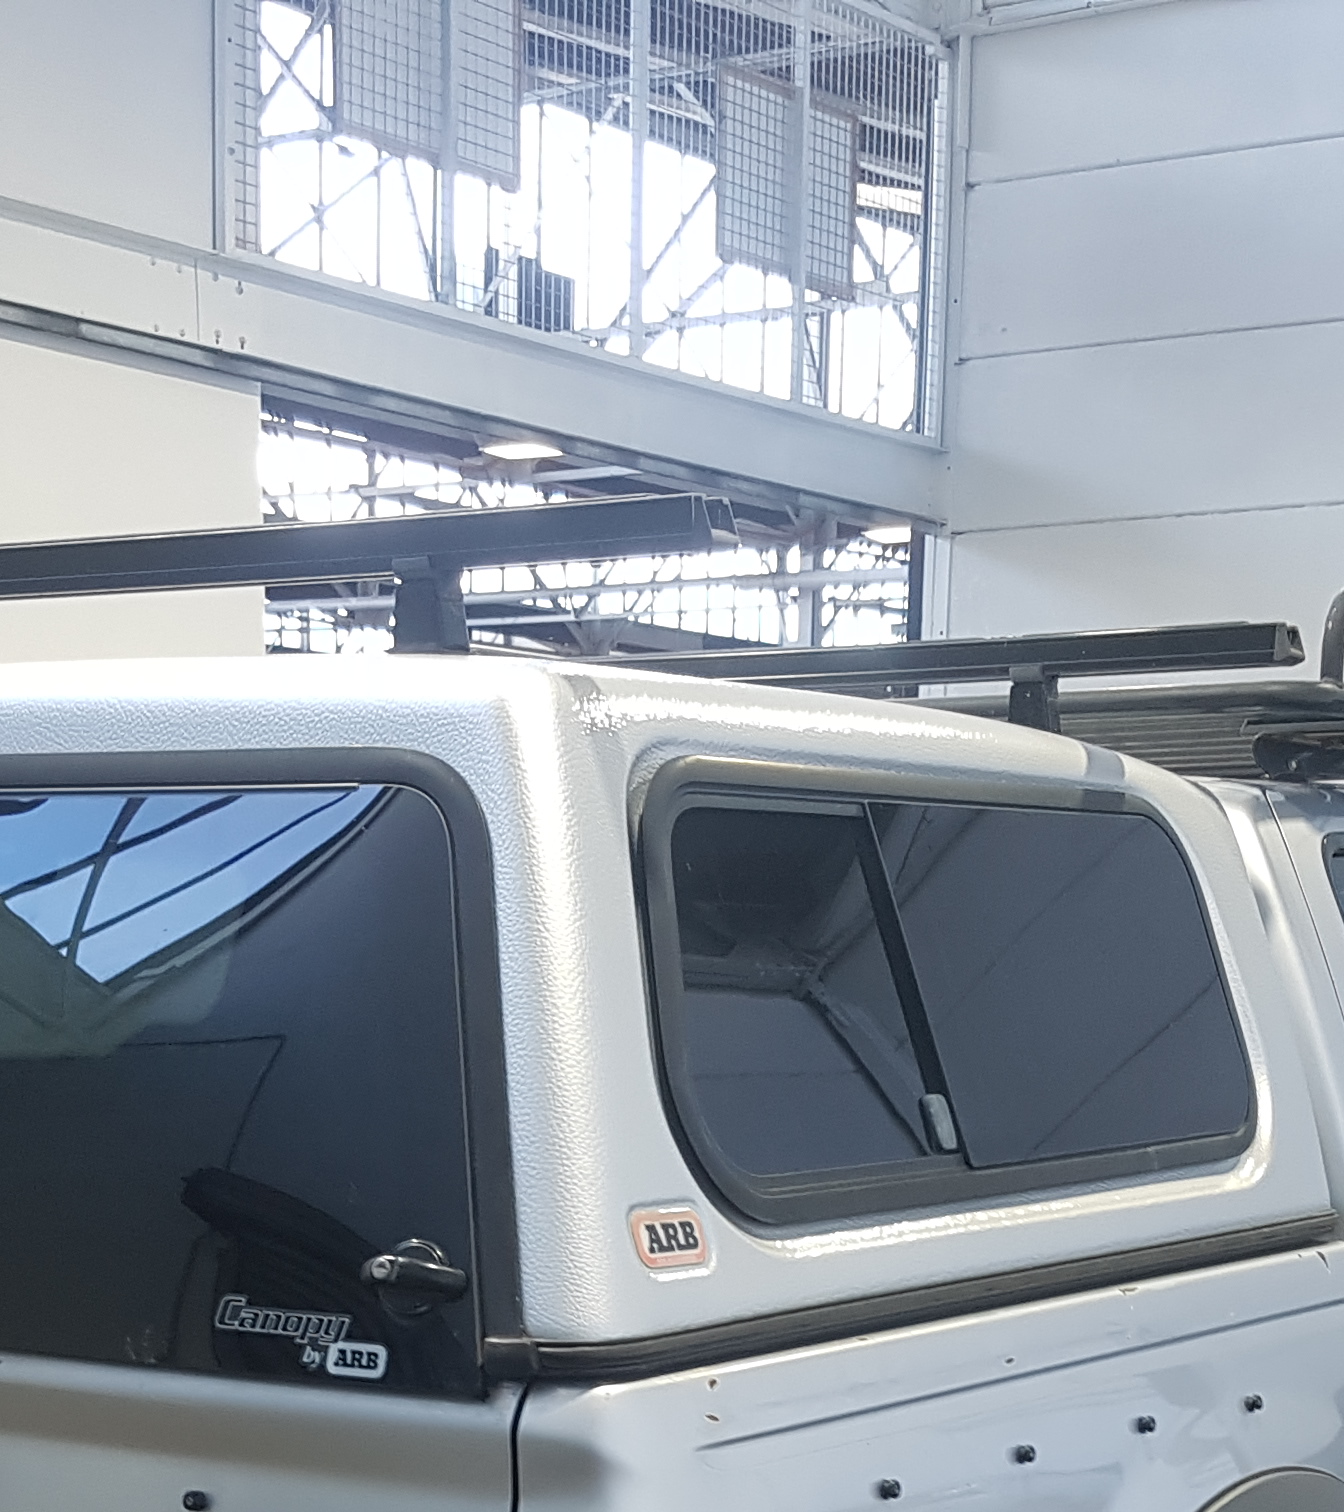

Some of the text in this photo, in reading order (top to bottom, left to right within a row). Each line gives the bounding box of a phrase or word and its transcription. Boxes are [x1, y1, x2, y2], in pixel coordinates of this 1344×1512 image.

[643, 1220, 699, 1254] ARB
[214, 1295, 351, 1346] Canopy
[301, 1345, 379, 1371] by ARB
